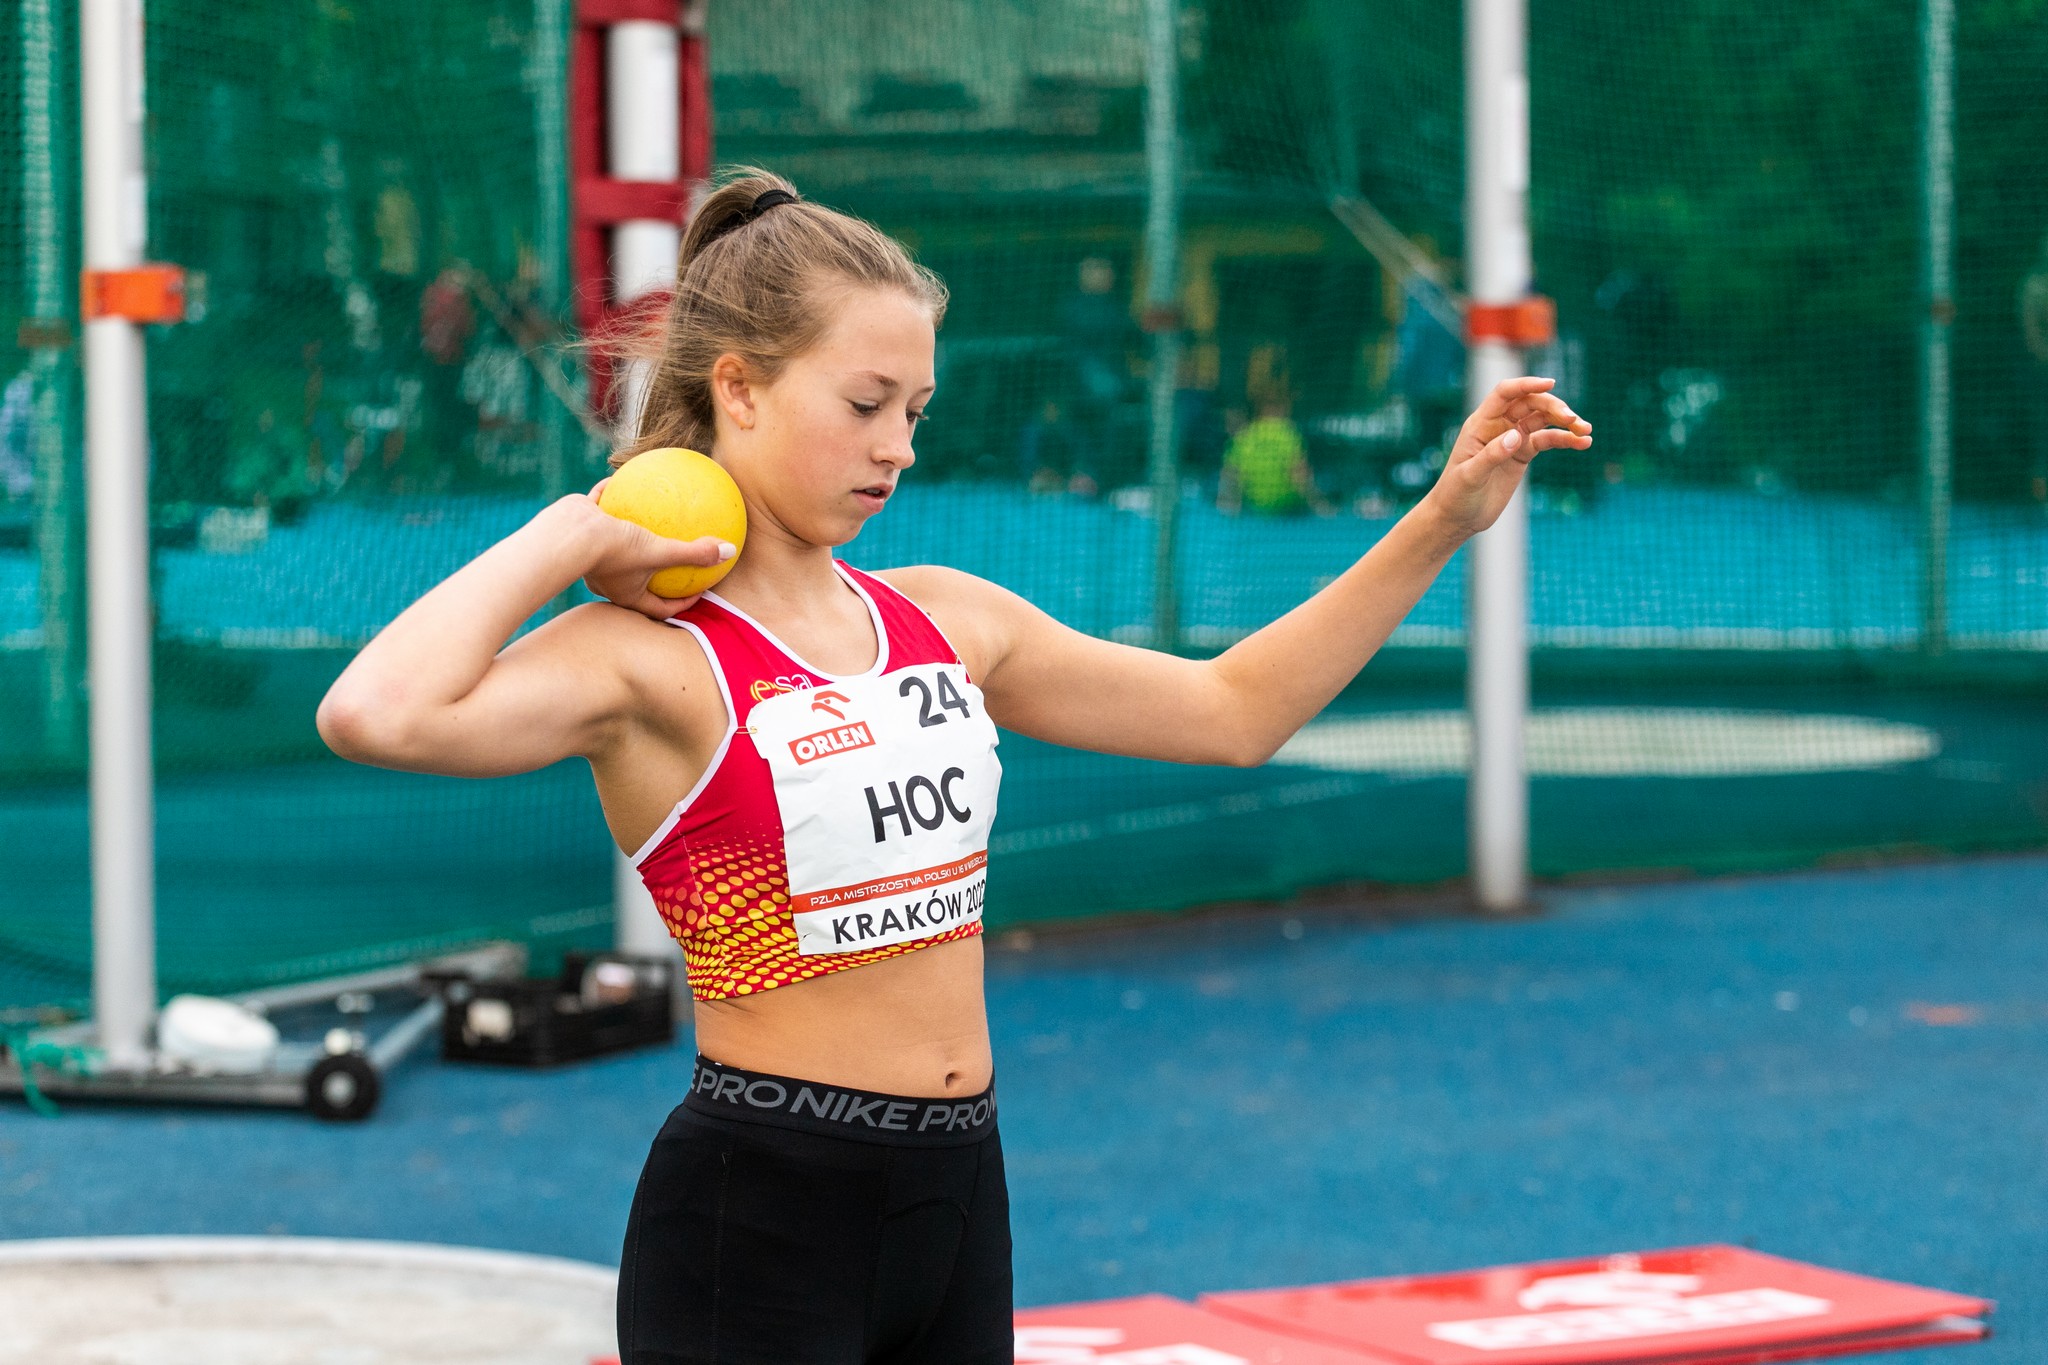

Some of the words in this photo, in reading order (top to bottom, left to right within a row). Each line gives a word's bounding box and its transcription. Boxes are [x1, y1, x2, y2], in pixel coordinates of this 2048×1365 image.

[899, 671, 970, 728] 24
[795, 727, 870, 760] ORLEN
[864, 767, 972, 843] HOC
[810, 893, 842, 907] PZLA
[843, 876, 924, 900] MISTRZOSTWA
[925, 869, 951, 882] POLSKI
[832, 889, 962, 945] KRAKÓW
[699, 1067, 787, 1108] PRO
[789, 1086, 918, 1131] NIKE
[917, 1098, 989, 1132] PRO
